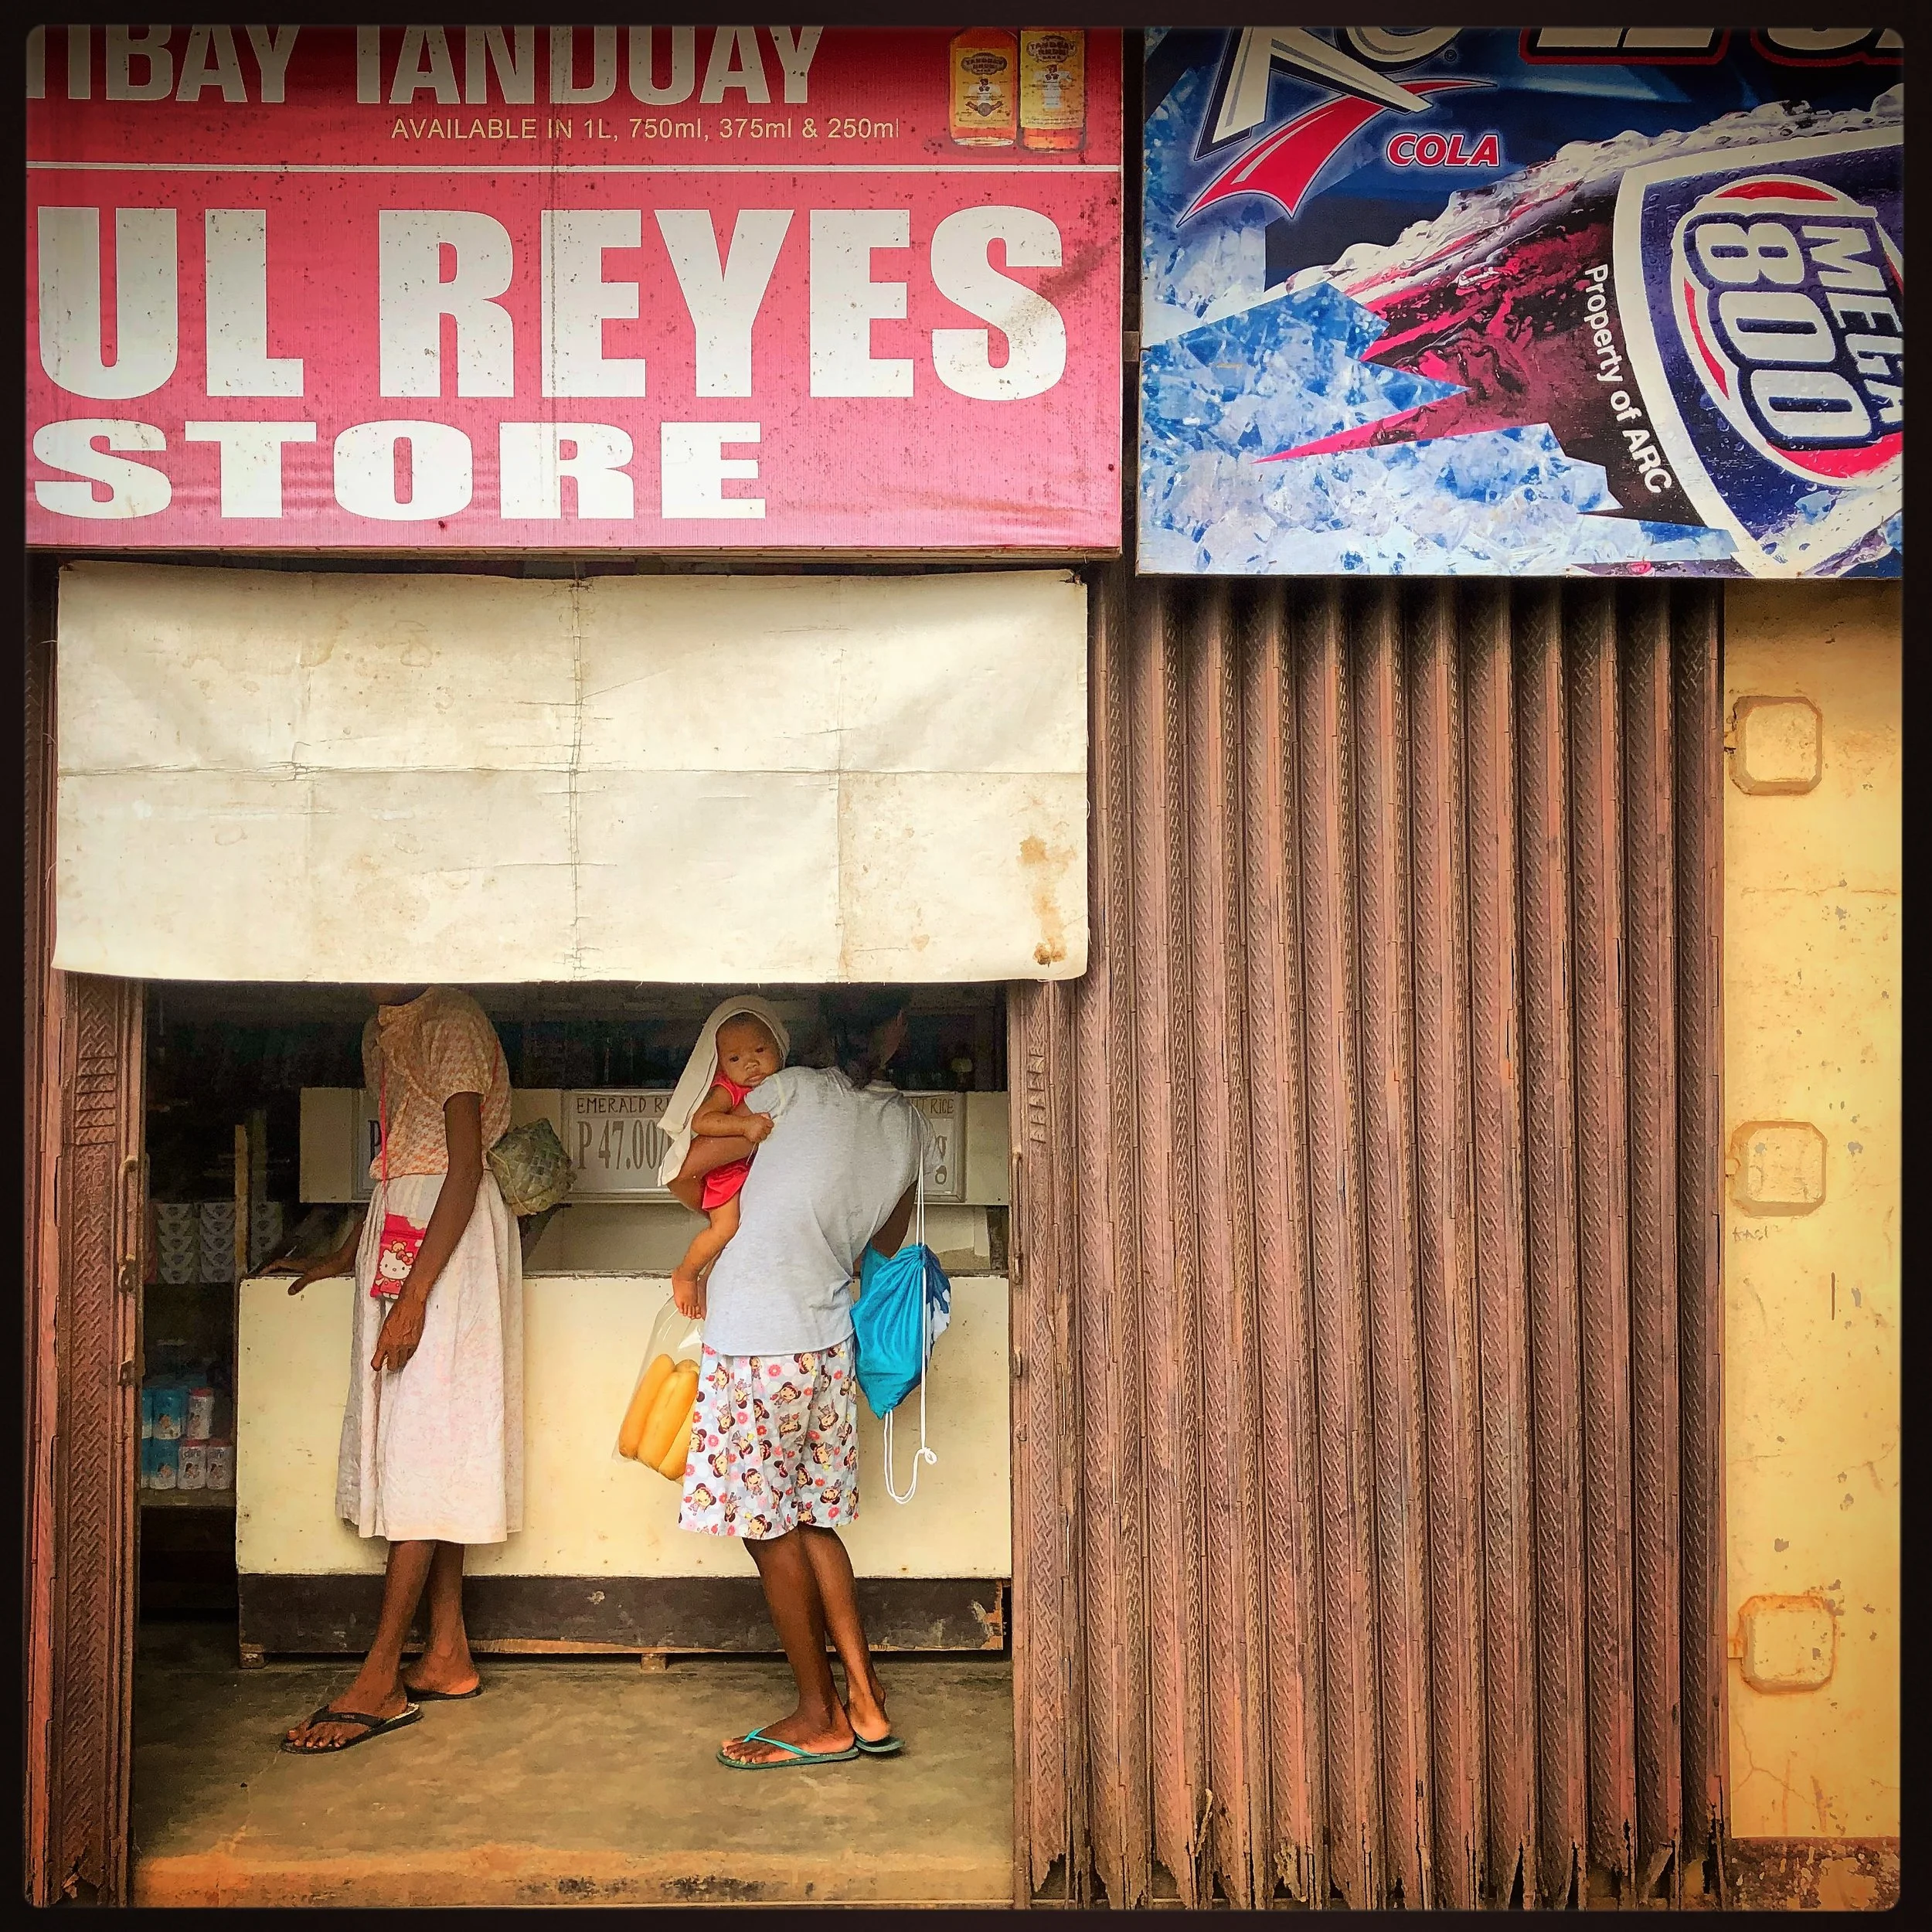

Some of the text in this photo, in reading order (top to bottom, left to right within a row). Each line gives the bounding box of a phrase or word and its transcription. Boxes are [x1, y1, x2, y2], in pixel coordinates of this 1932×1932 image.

[391, 118, 899, 142] AVAILABLE IN 1L, 750ml, 375ml & 250ml
[1387, 132, 1500, 167] COLA
[37, 205, 1067, 401] UL REYES
[1695, 222, 1873, 437] 800
[1584, 264, 1672, 494] Property of ARC
[32, 418, 766, 521] STORE
[577, 1097, 647, 1114] EMERALD
[930, 1099, 954, 1114] RICE
